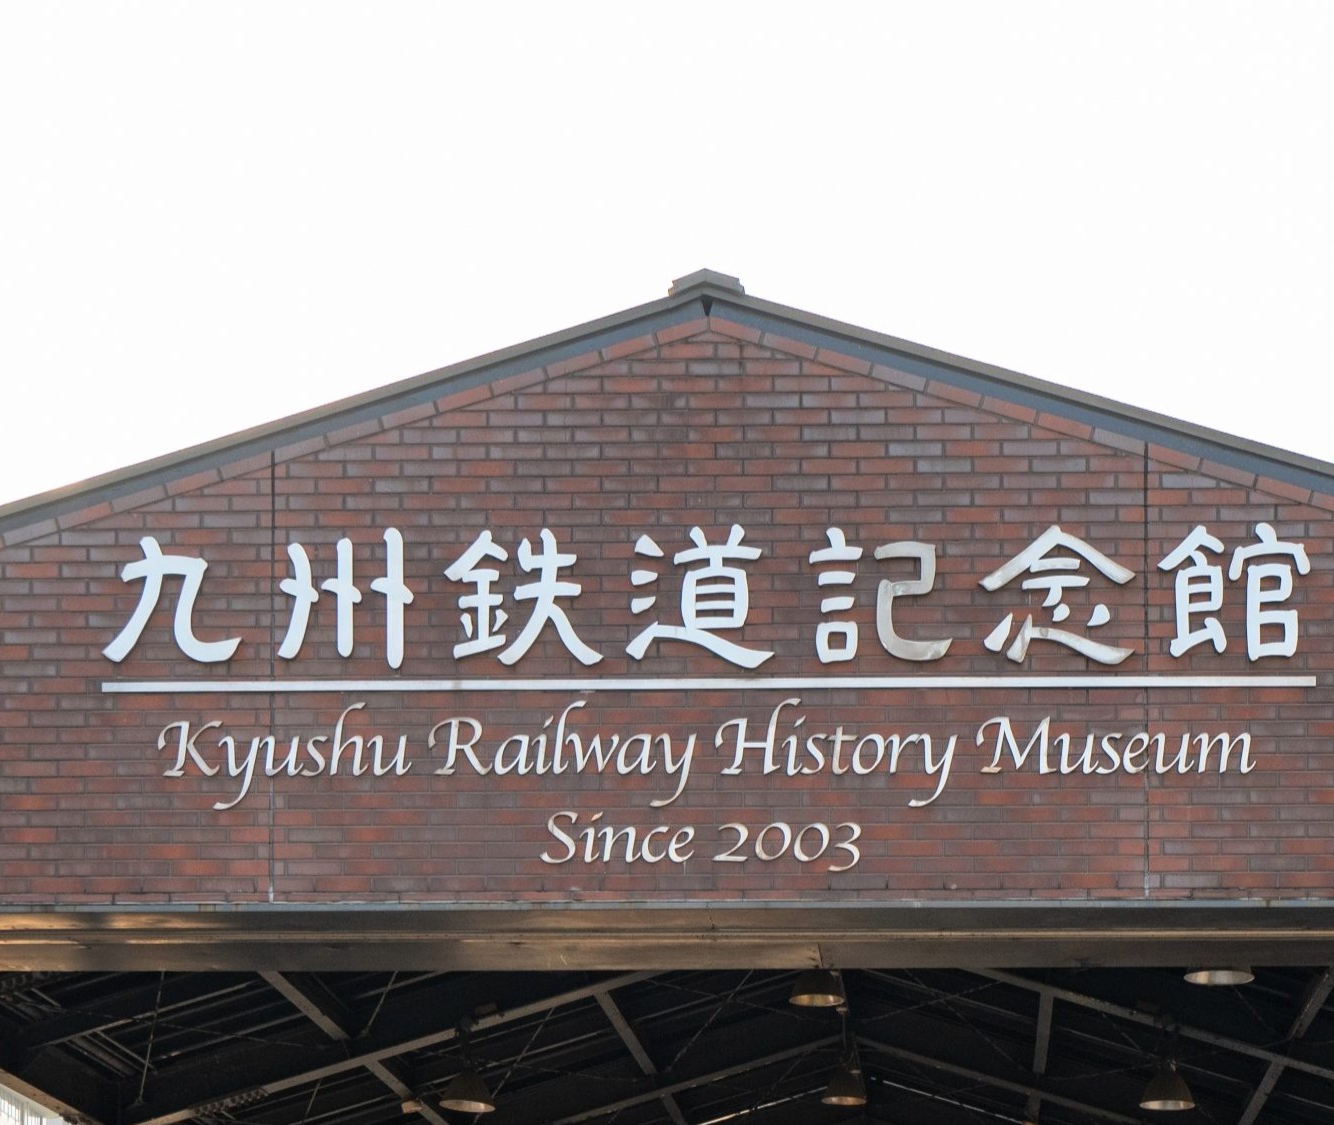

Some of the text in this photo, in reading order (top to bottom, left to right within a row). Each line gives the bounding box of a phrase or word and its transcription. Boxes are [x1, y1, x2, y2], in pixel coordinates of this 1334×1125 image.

[101, 523, 1312, 670] 九州鉄道記念館
[158, 698, 1258, 810] Kyushu Railway History Museum
[539, 811, 862, 873] Since 2003
